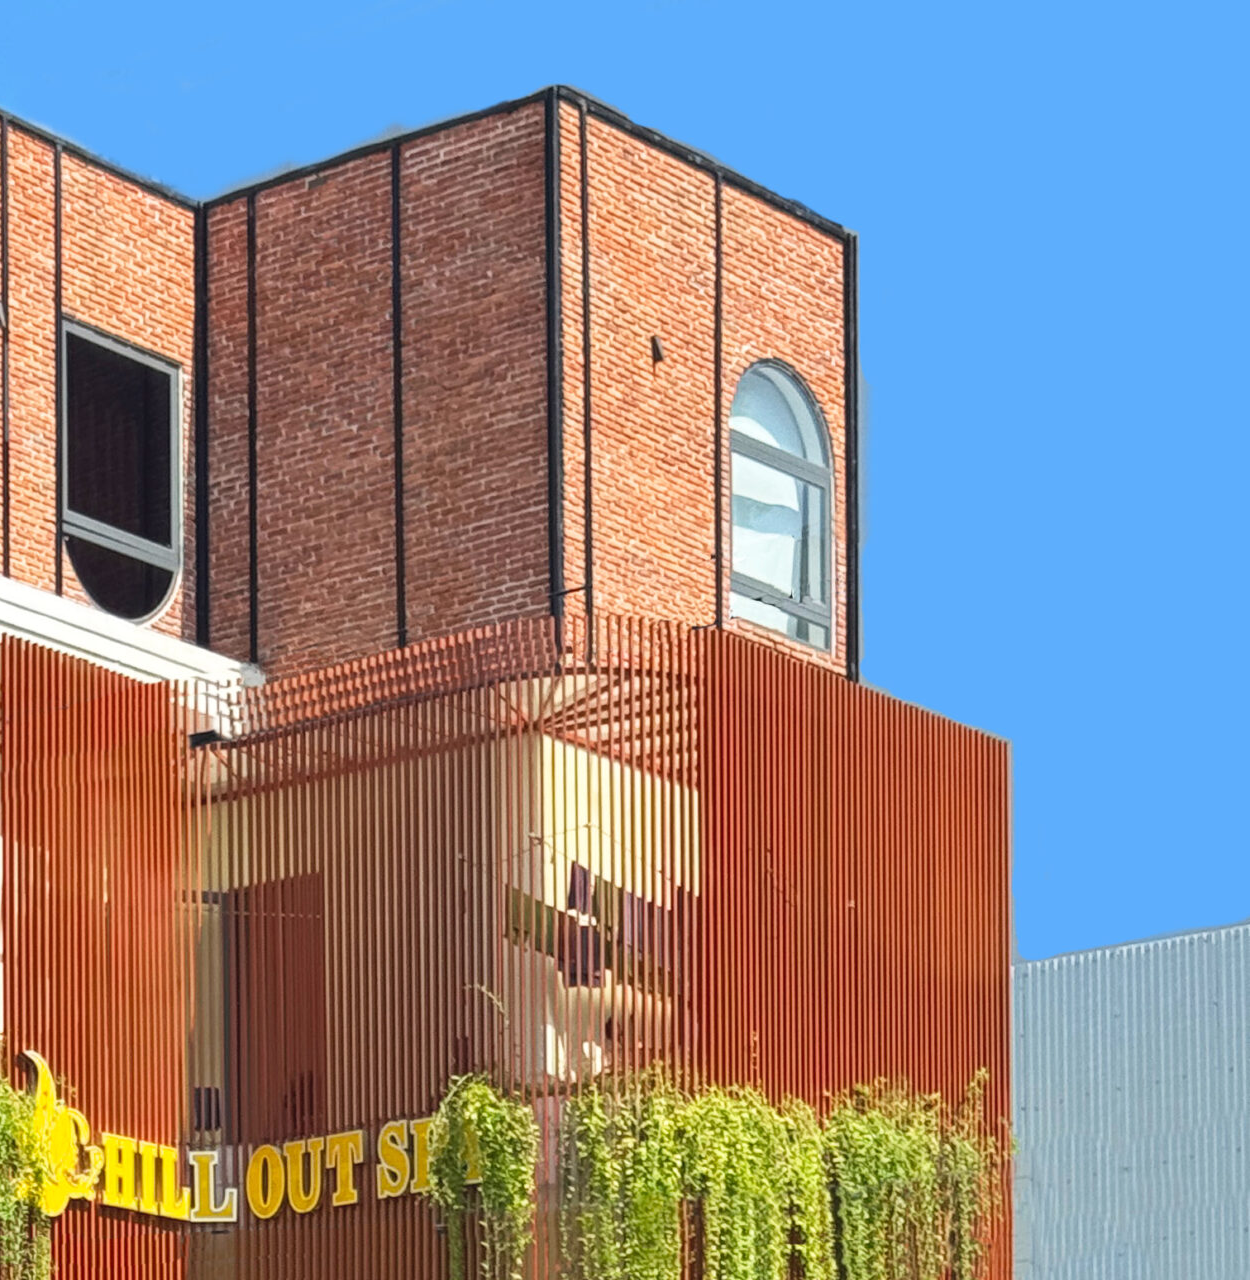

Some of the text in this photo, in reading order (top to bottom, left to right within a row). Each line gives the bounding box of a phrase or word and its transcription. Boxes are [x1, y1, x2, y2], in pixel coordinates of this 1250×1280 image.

[46, 1107, 482, 1223] CHILL OUT SP
